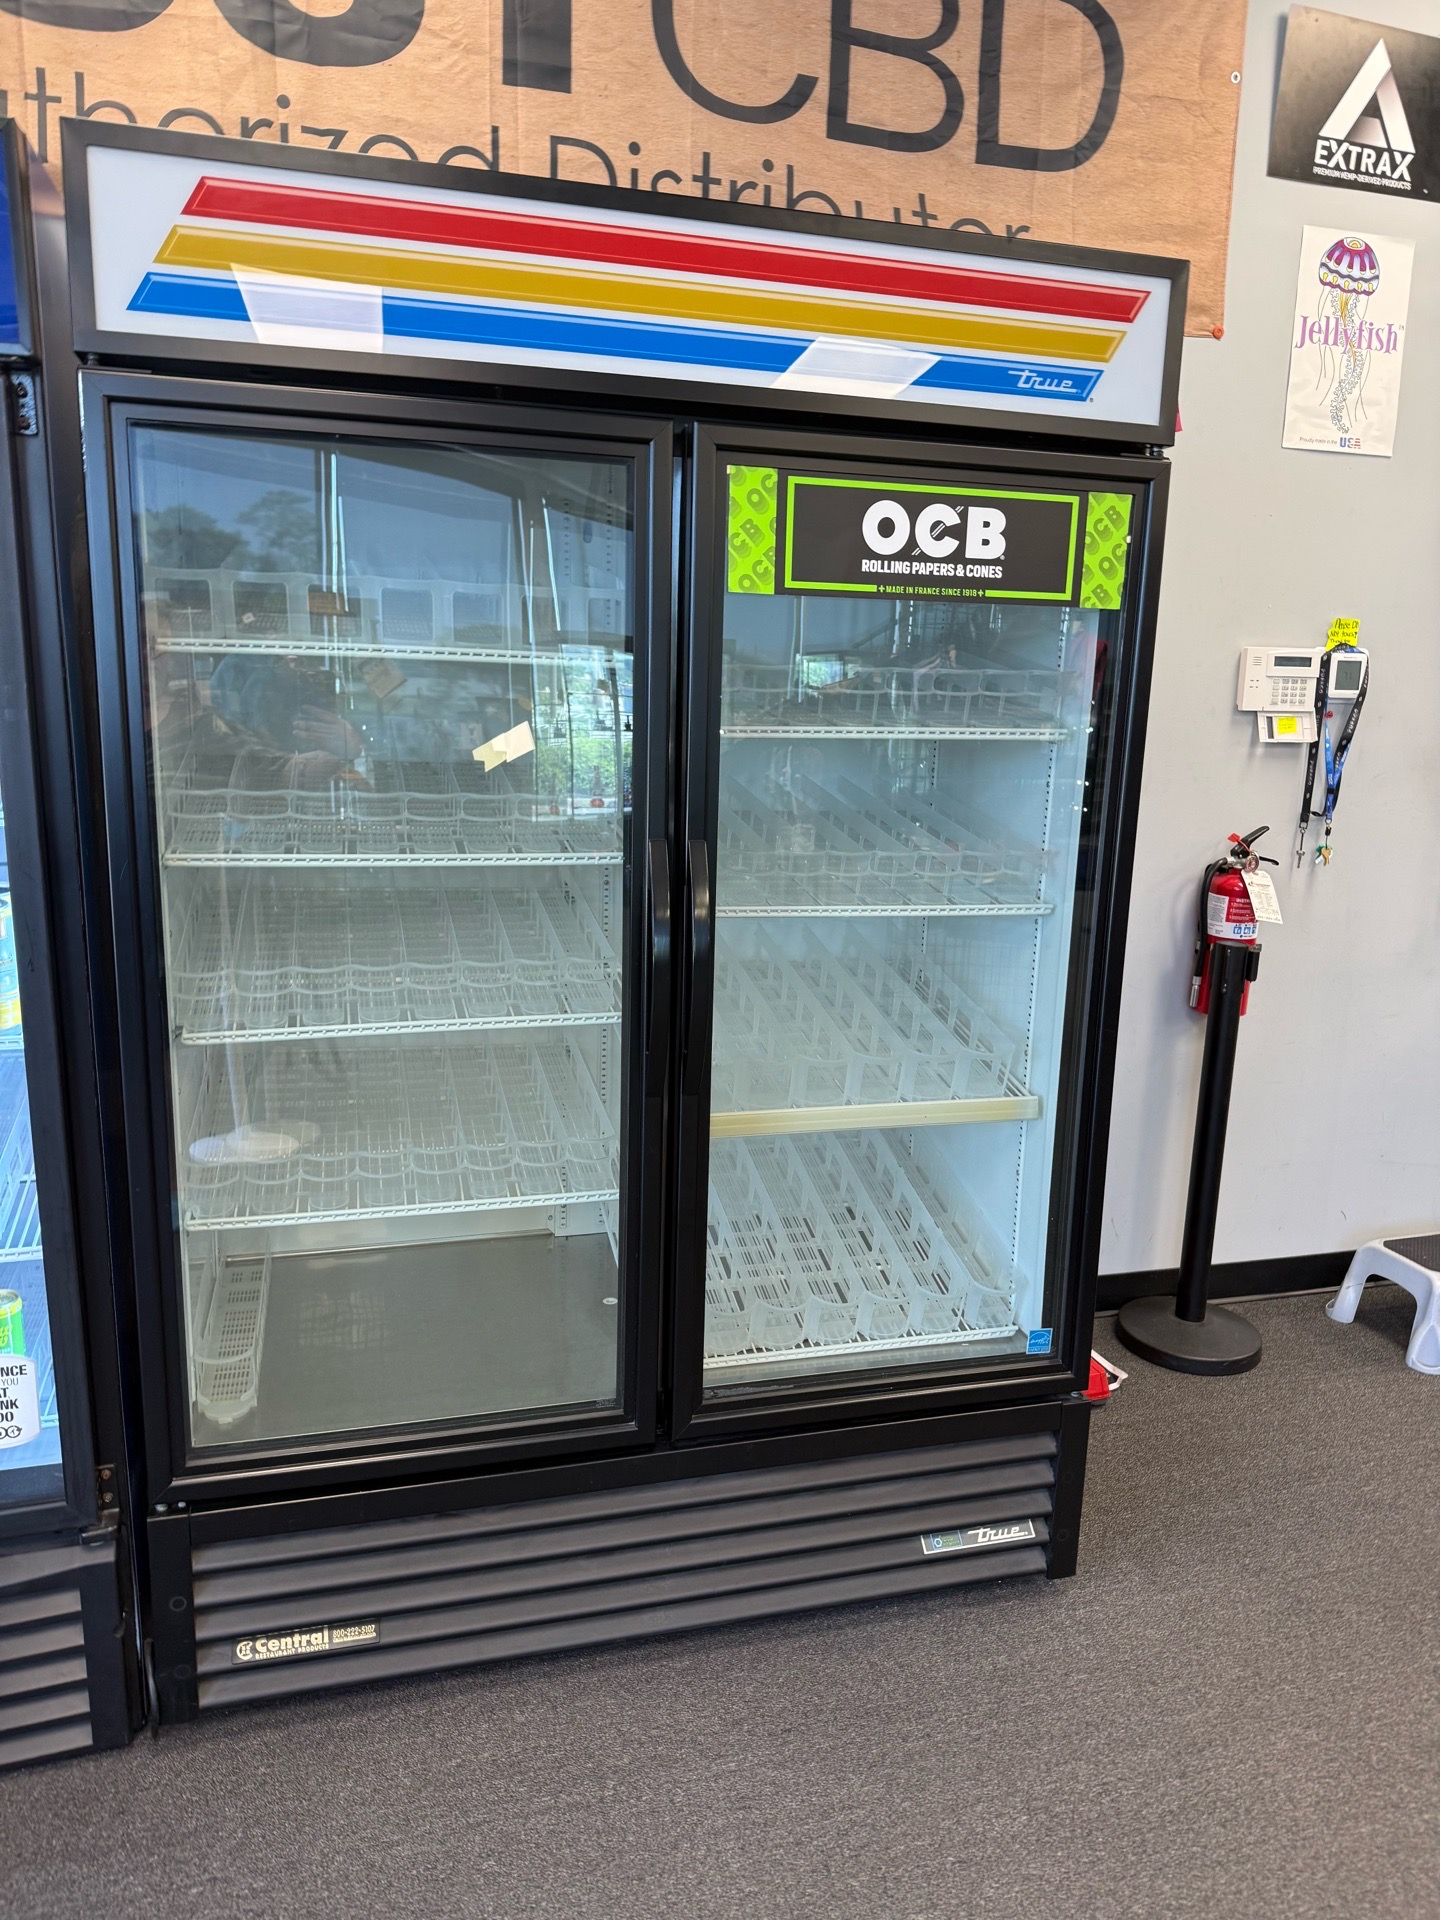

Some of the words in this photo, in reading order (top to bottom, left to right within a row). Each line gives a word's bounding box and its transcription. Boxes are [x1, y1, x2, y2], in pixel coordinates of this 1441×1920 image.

[1314, 139, 1414, 182] EXTRAX
[1294, 315, 1398, 354] Jellyfish
[1340, 437, 1361, 449] USA
[862, 500, 1006, 560] OCB
[861, 559, 910, 574] ROLLING
[912, 562, 955, 577] PAPERS
[955, 563, 965, 577] &
[966, 564, 1003, 579] CONES
[886, 585, 904, 594] MADE
[906, 586, 914, 594] IN
[914, 586, 940, 596] FRANCE
[941, 588, 961, 597] SINCE
[2, 1377, 18, 1386] YOU
[255, 1627, 329, 1653] Central
[255, 1649, 296, 1660] RESTAURANT
[297, 1643, 329, 1654] PRODUCTS
